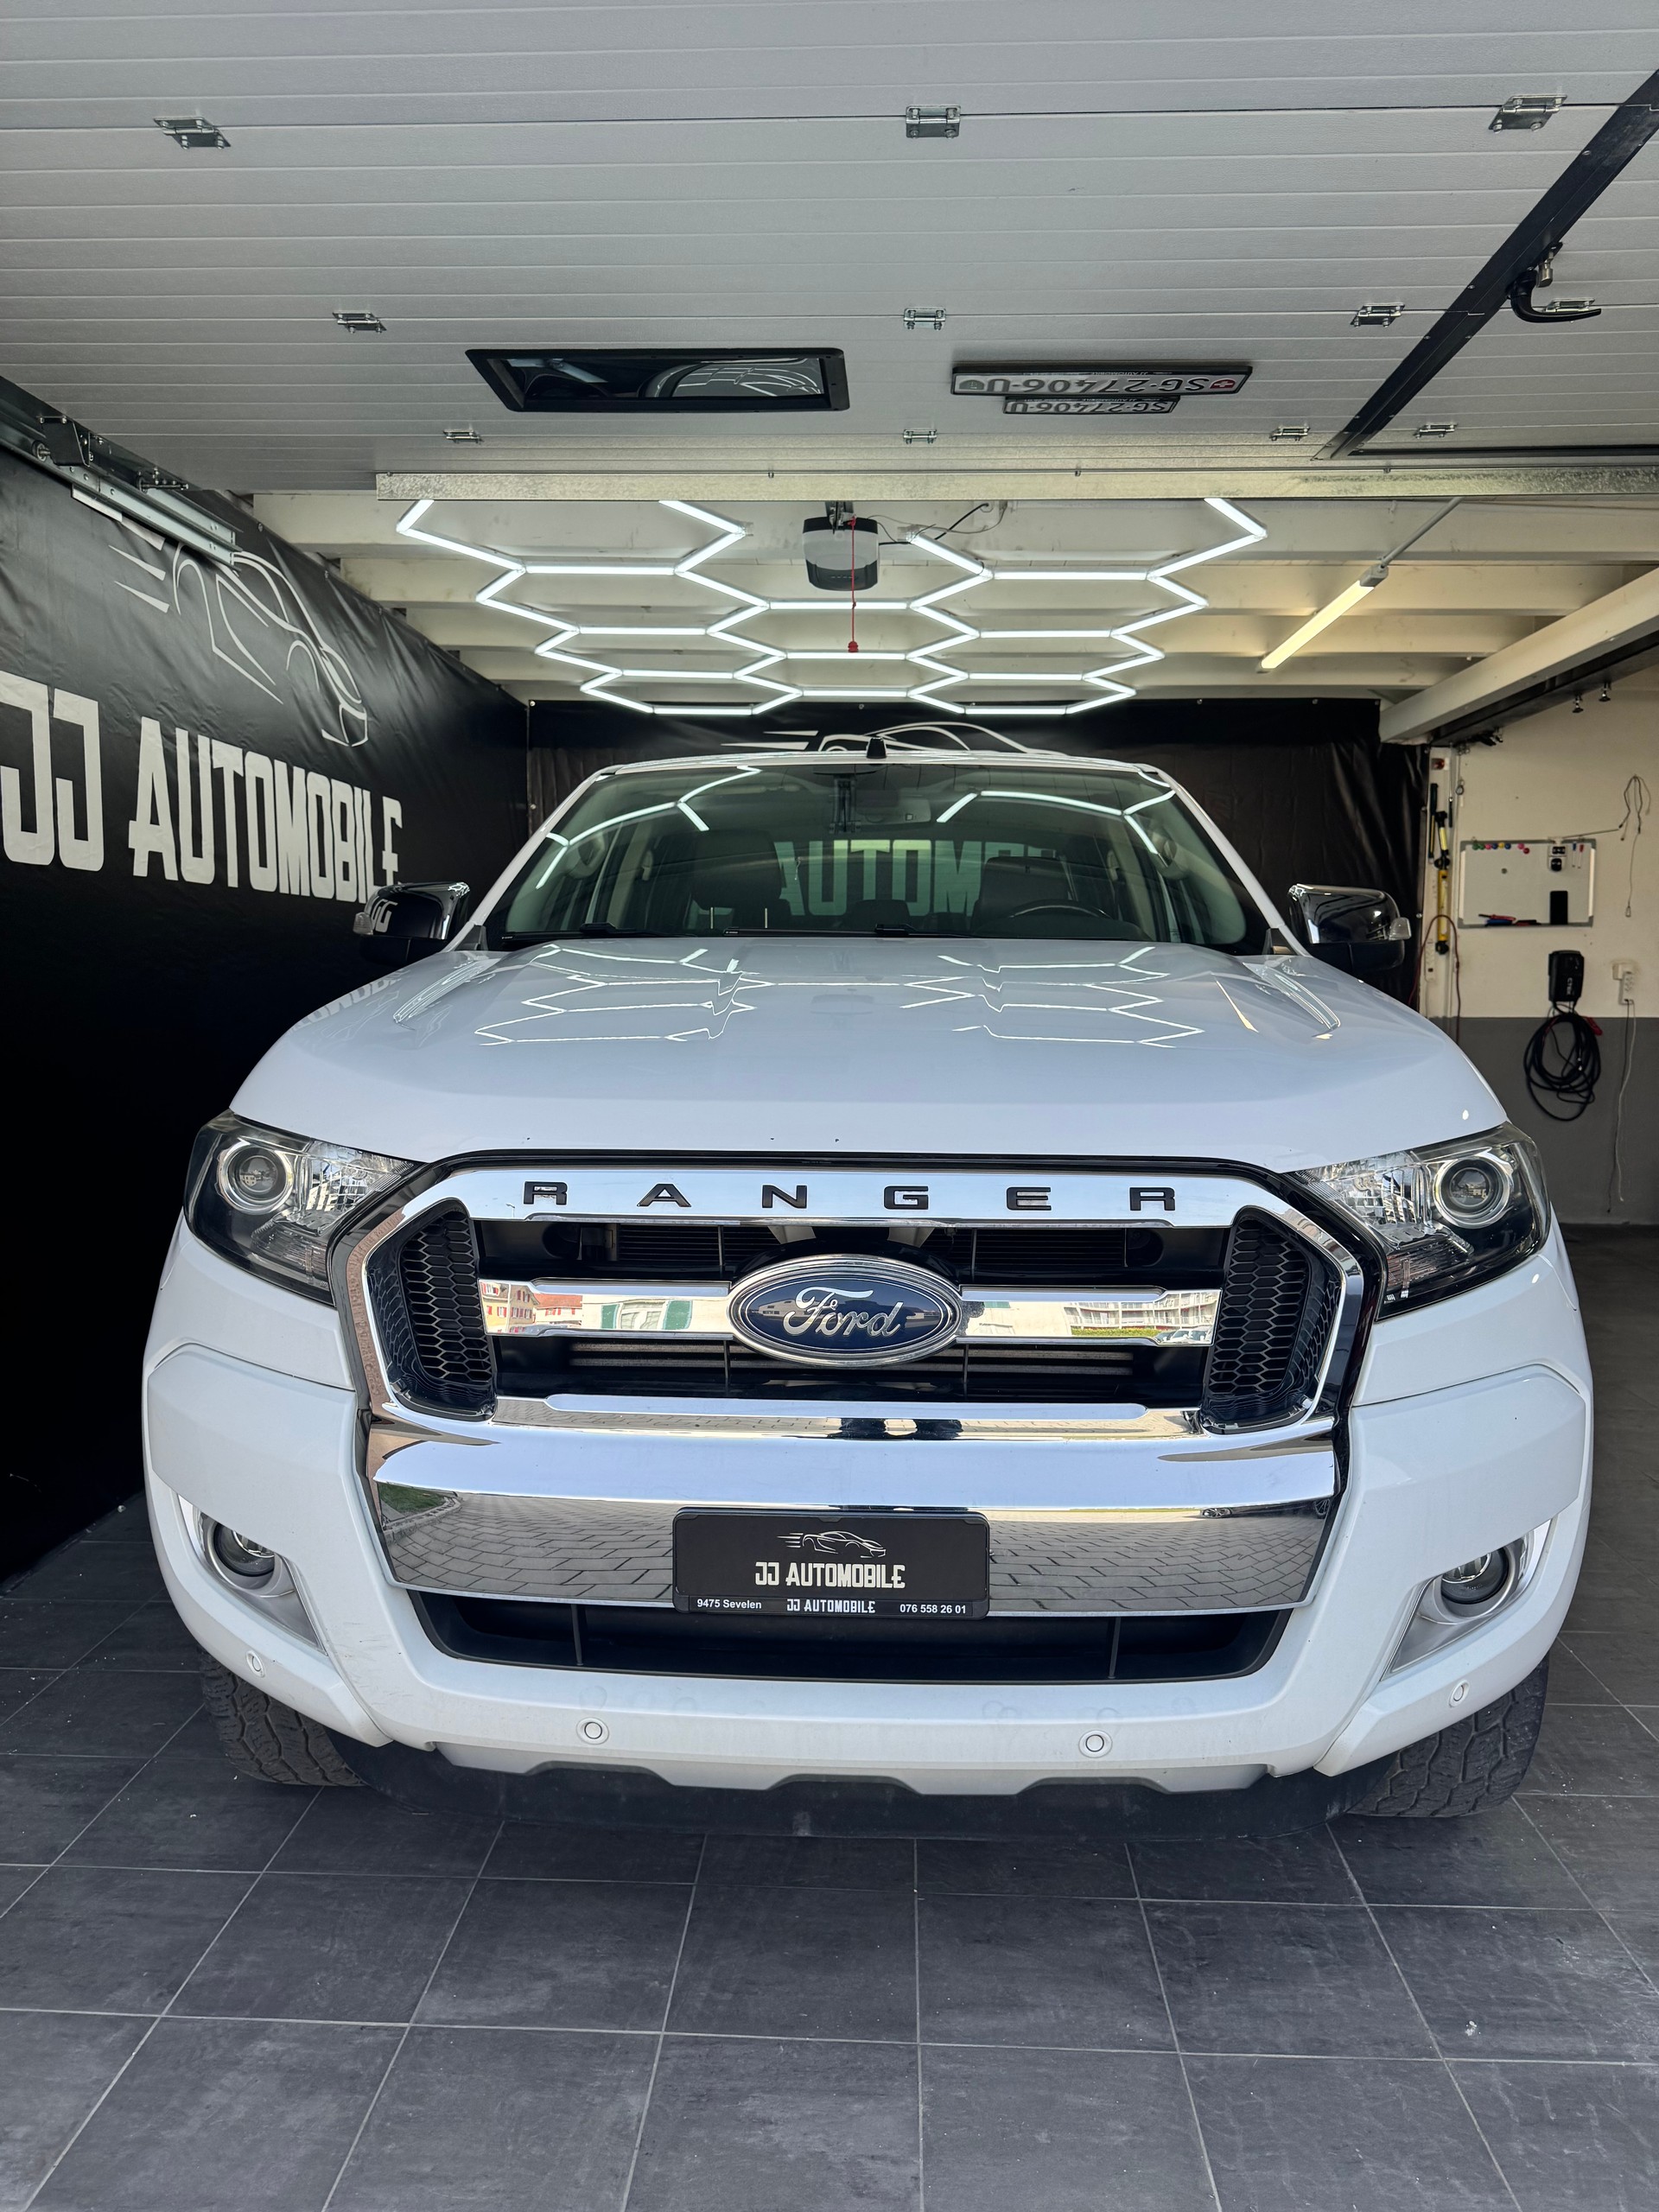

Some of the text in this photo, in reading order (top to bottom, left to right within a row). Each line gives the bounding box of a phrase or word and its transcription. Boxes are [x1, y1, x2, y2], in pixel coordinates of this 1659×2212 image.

[0, 671, 105, 872] JJ
[522, 1180, 1177, 1212] RANGER
[782, 1285, 904, 1337] Ford
[754, 1561, 906, 1589] JJ AUTOMOBILE
[697, 1599, 762, 1609] 9475 Sevelen
[786, 1599, 875, 1613] JJ AUTOMOBILE
[899, 1604, 966, 1614] 076 558 26 01
